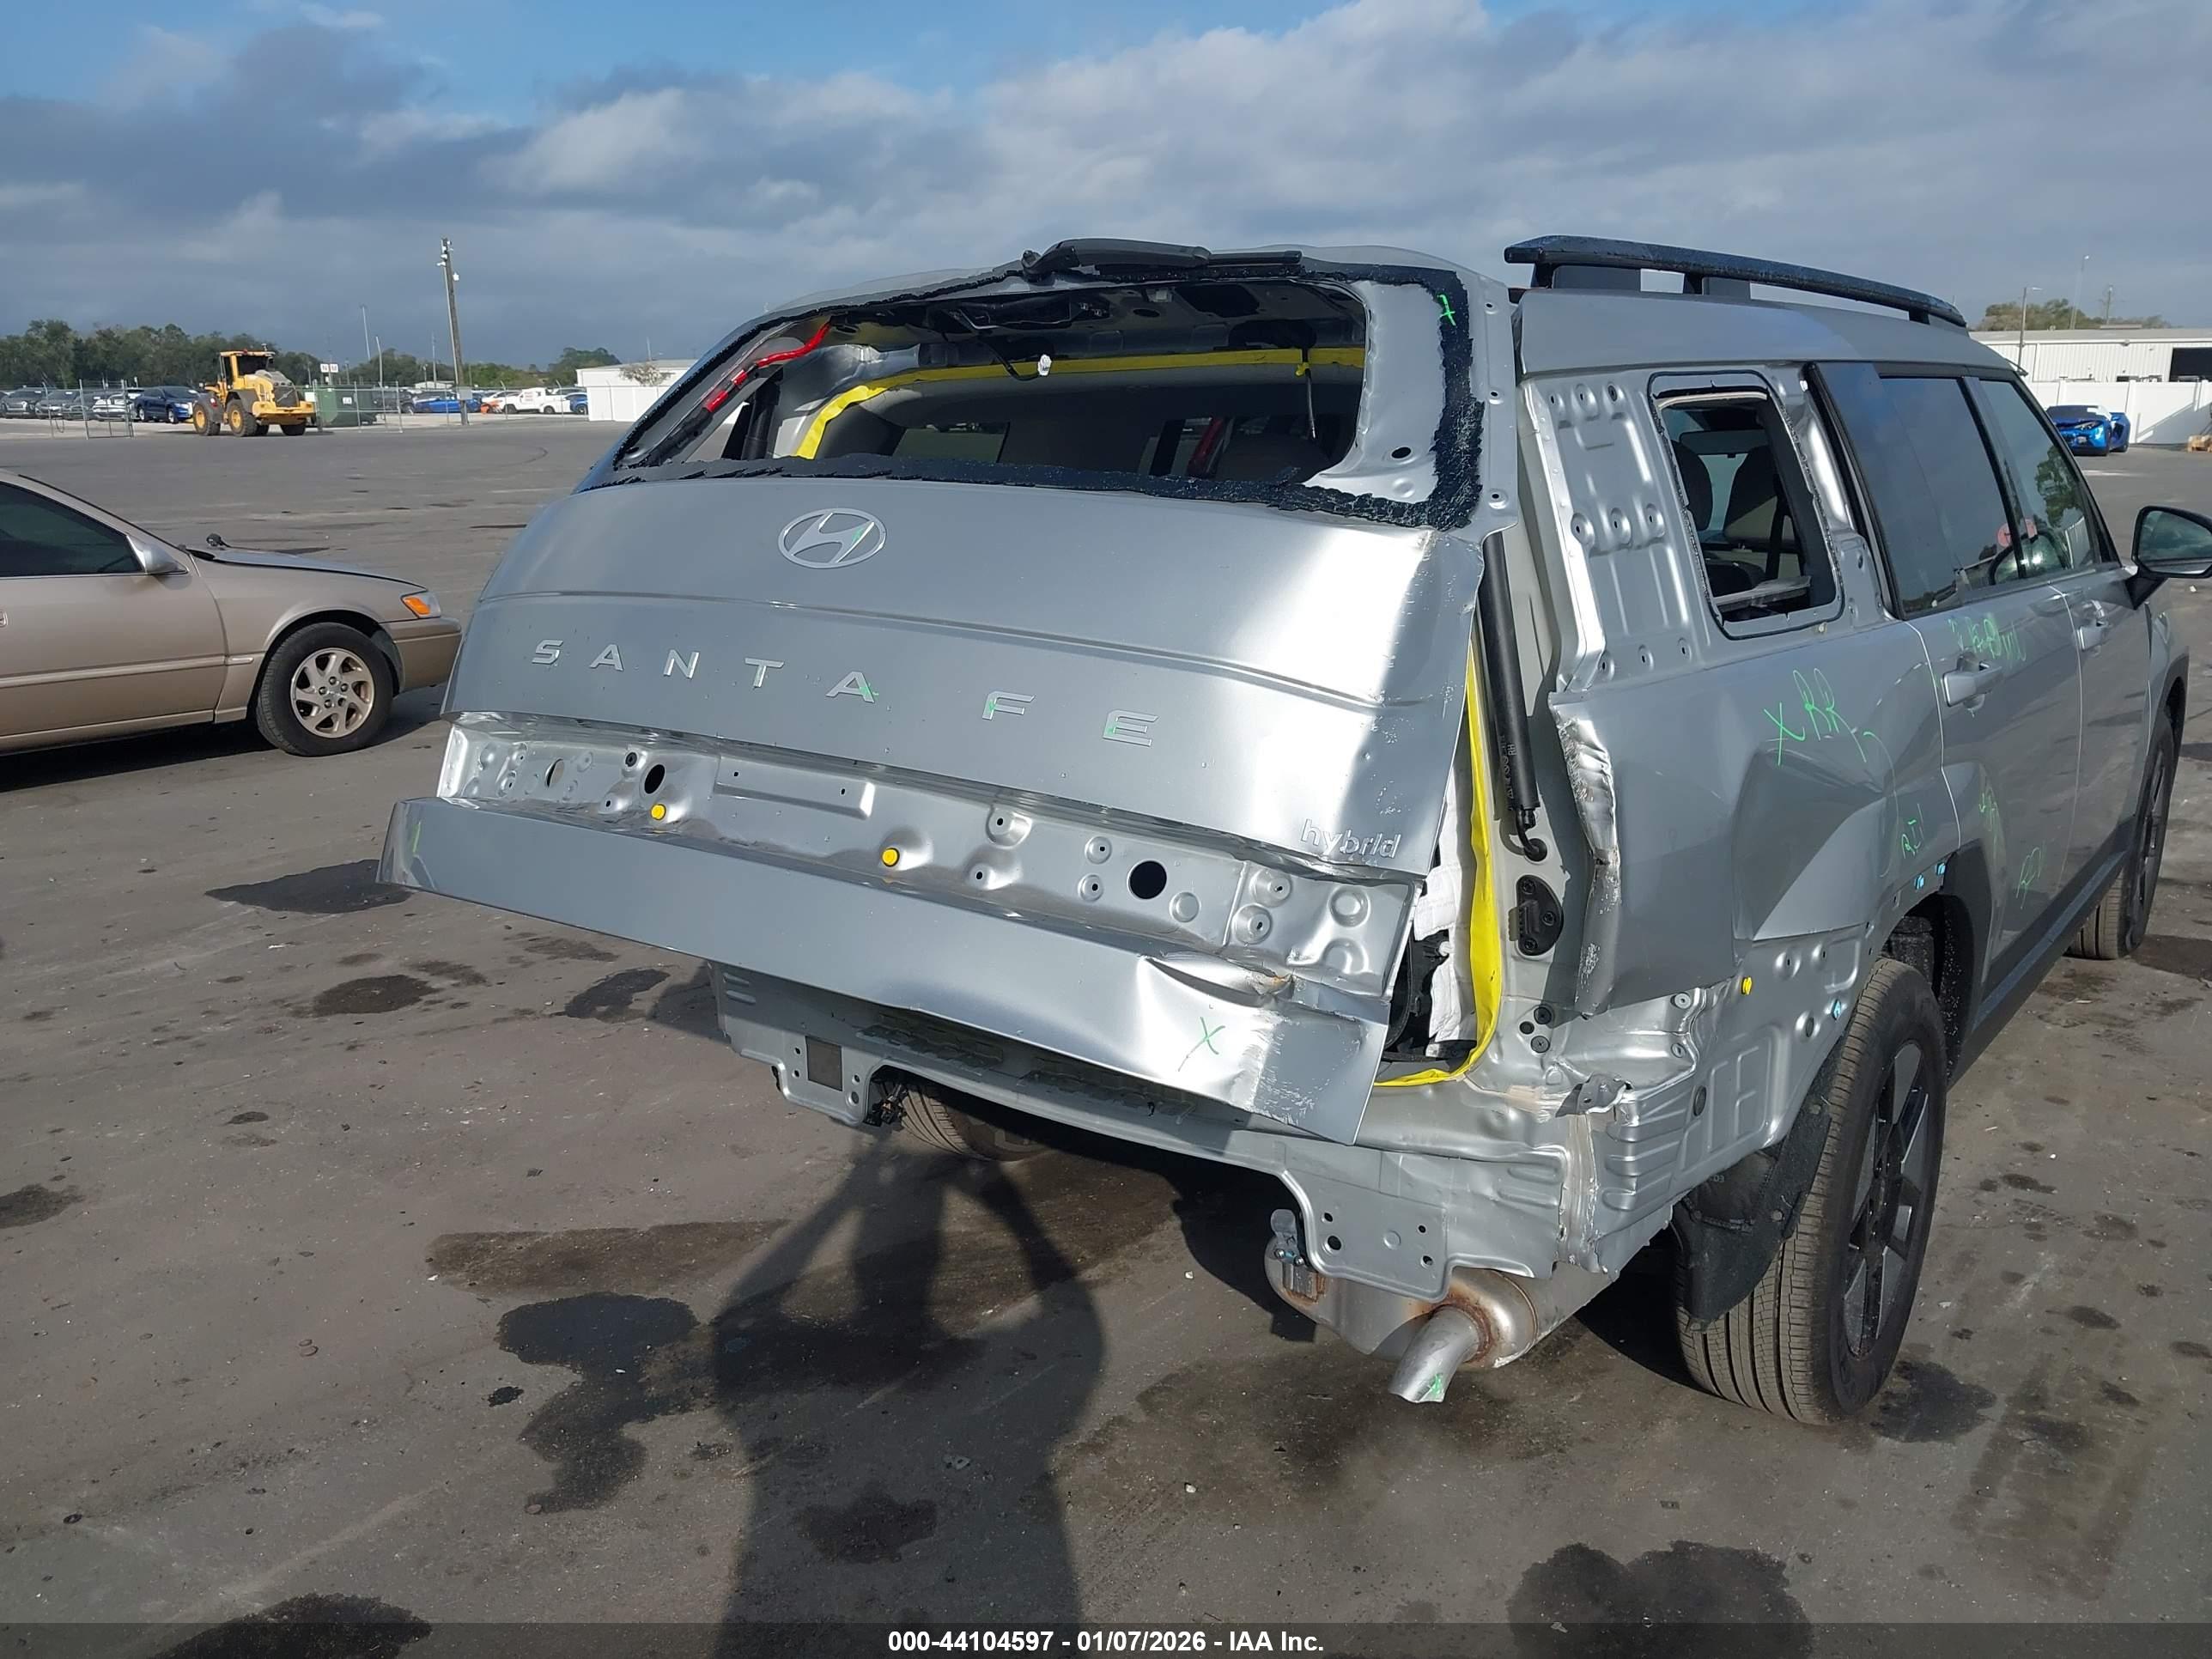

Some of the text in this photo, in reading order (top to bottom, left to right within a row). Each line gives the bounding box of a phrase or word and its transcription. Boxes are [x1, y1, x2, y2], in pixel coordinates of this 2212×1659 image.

[532, 639, 1159, 748] SANTA FE
[1300, 818, 1402, 860] hybrid
